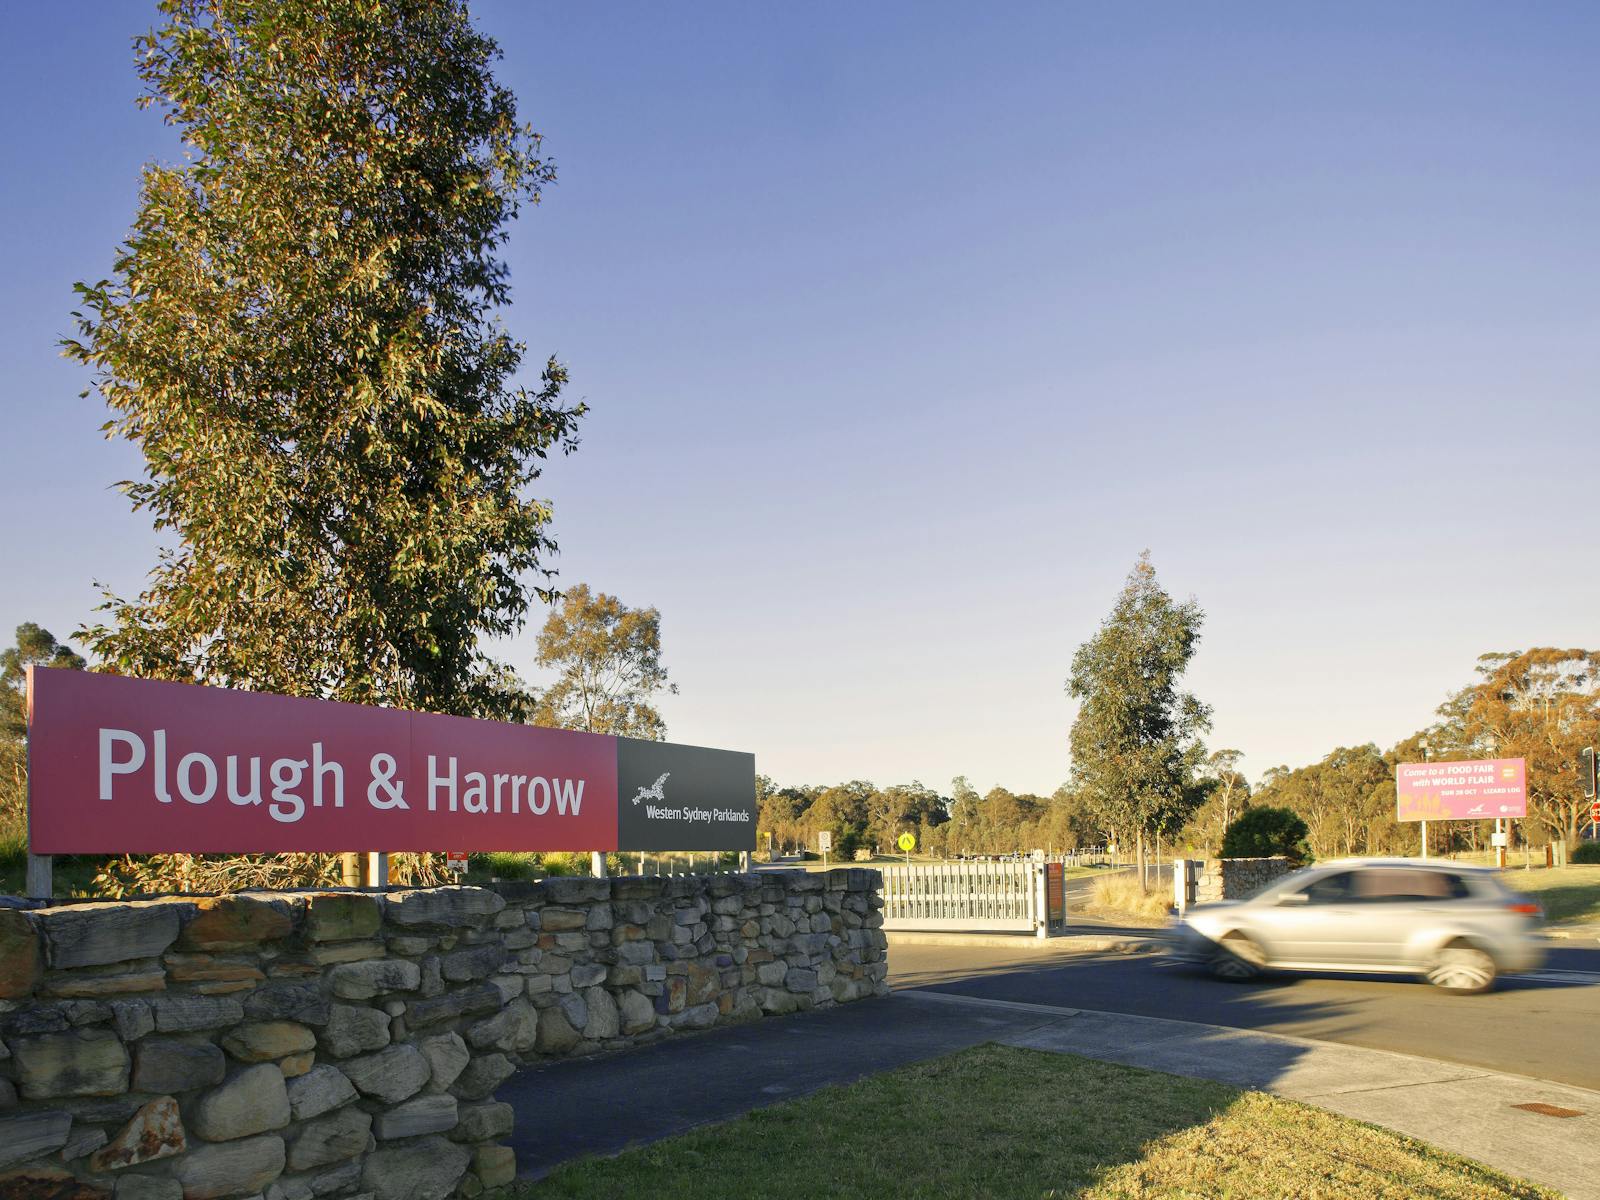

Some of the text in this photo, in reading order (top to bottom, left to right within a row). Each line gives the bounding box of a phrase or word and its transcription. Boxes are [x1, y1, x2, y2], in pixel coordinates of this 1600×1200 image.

[99, 728, 585, 822] Plough & Harrow
[1403, 768, 1427, 777] Come
[1447, 766, 1472, 775] FOOD
[1474, 764, 1495, 773] FAIR
[1432, 777, 1466, 786] WORLD
[1468, 775, 1495, 784] FLAIR
[646, 804, 750, 824] Western Sydney Parklands
